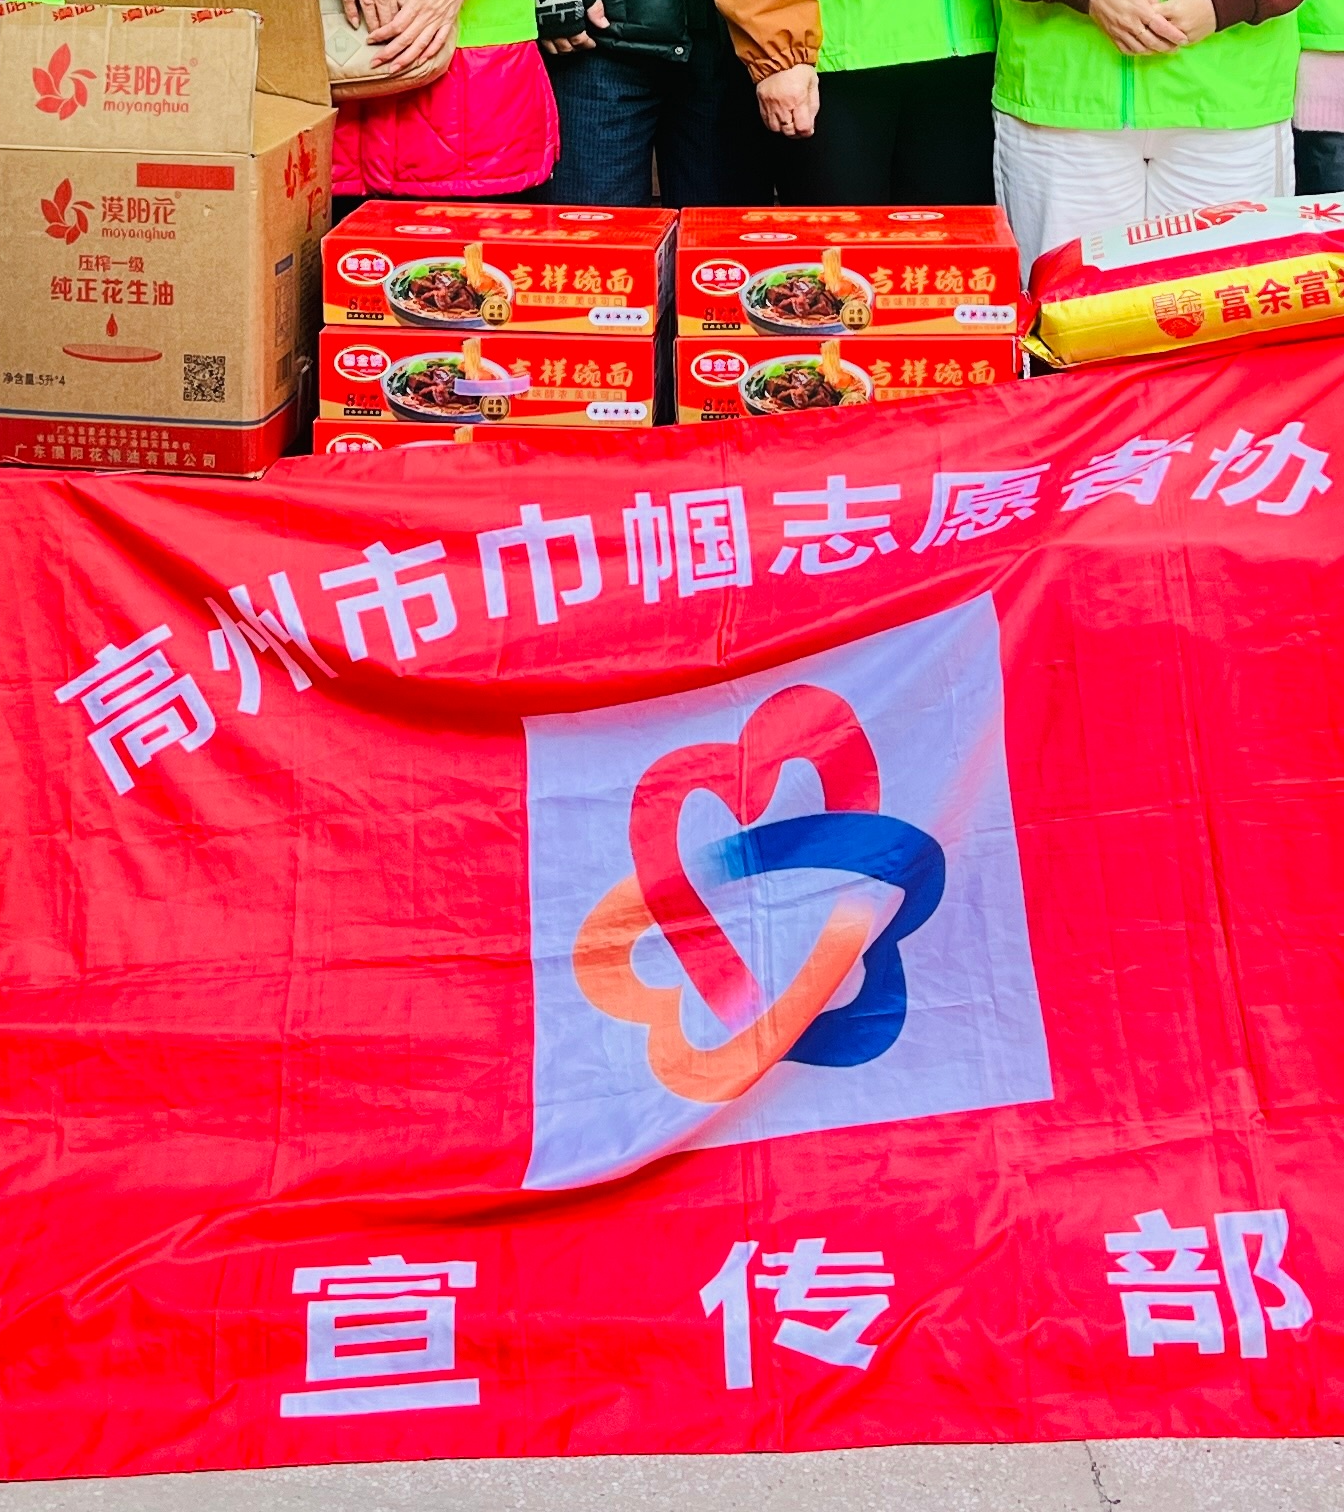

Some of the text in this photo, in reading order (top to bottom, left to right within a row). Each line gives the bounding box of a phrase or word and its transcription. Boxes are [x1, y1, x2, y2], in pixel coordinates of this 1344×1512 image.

[103, 64, 191, 97] 漠阳花
[103, 98, 189, 116] moyanghua
[101, 195, 177, 226] 漠阳花
[101, 227, 177, 241] moyanghua
[78, 254, 145, 274] 压榨一级
[509, 263, 635, 294] 吉祥碗面
[50, 277, 175, 307] 纯正花生油
[869, 265, 997, 295] 吉祥碗面
[870, 358, 997, 387] 吉祥碗面
[279, 1208, 1314, 1420] 宣传部
